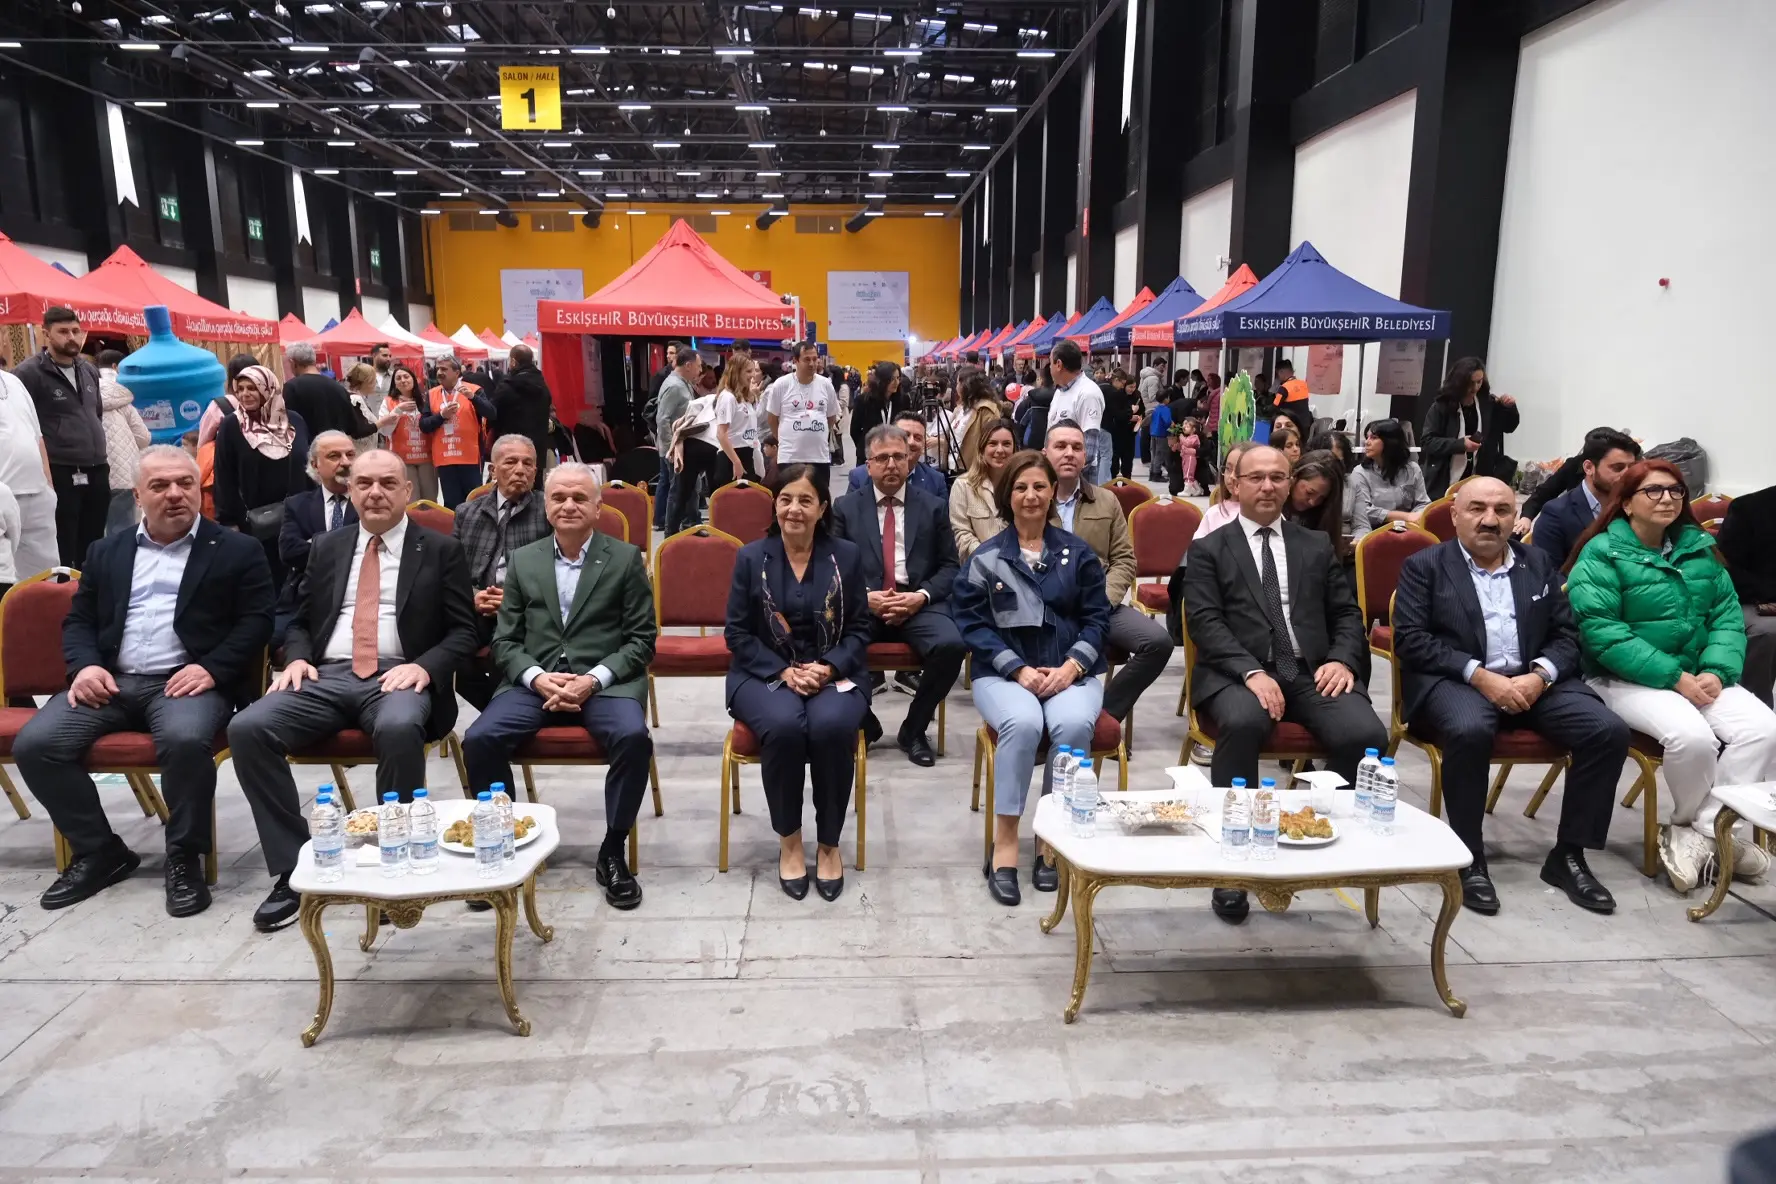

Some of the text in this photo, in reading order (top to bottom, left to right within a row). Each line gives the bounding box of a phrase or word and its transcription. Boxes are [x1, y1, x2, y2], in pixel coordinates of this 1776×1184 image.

[502, 72, 529, 81] SALON
[535, 72, 556, 81] HALL
[520, 88, 536, 123] 1
[628, 310, 709, 329] BÜYÜKŞEHİR
[1240, 314, 1435, 331] ESKİŞEHİR BÜYÜKŞEHİR BELEDİYESİ
